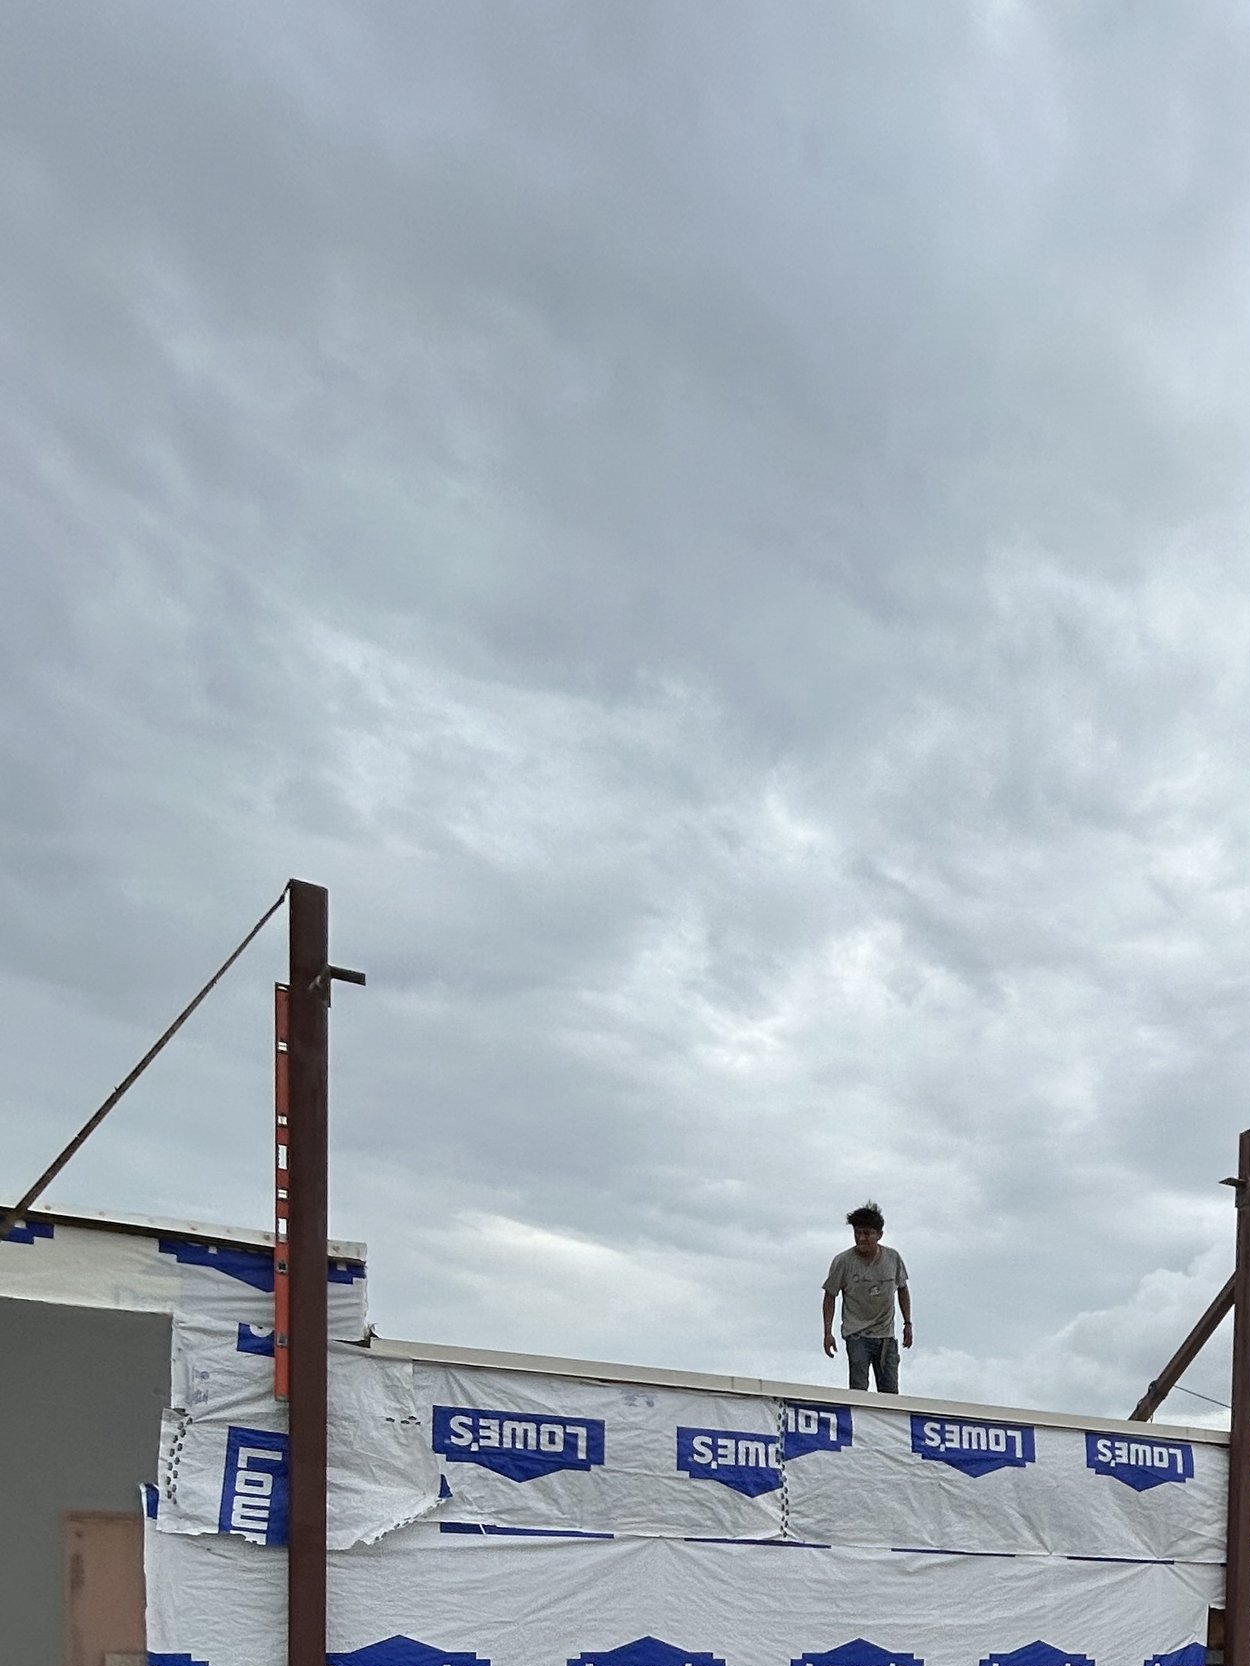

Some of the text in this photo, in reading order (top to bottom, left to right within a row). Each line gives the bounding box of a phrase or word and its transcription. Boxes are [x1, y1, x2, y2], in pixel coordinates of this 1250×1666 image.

[450, 1415, 588, 1461] LOWE'S
[923, 1422, 1023, 1458] LOWE'S
[1097, 1439, 1183, 1474] LOWE'S
